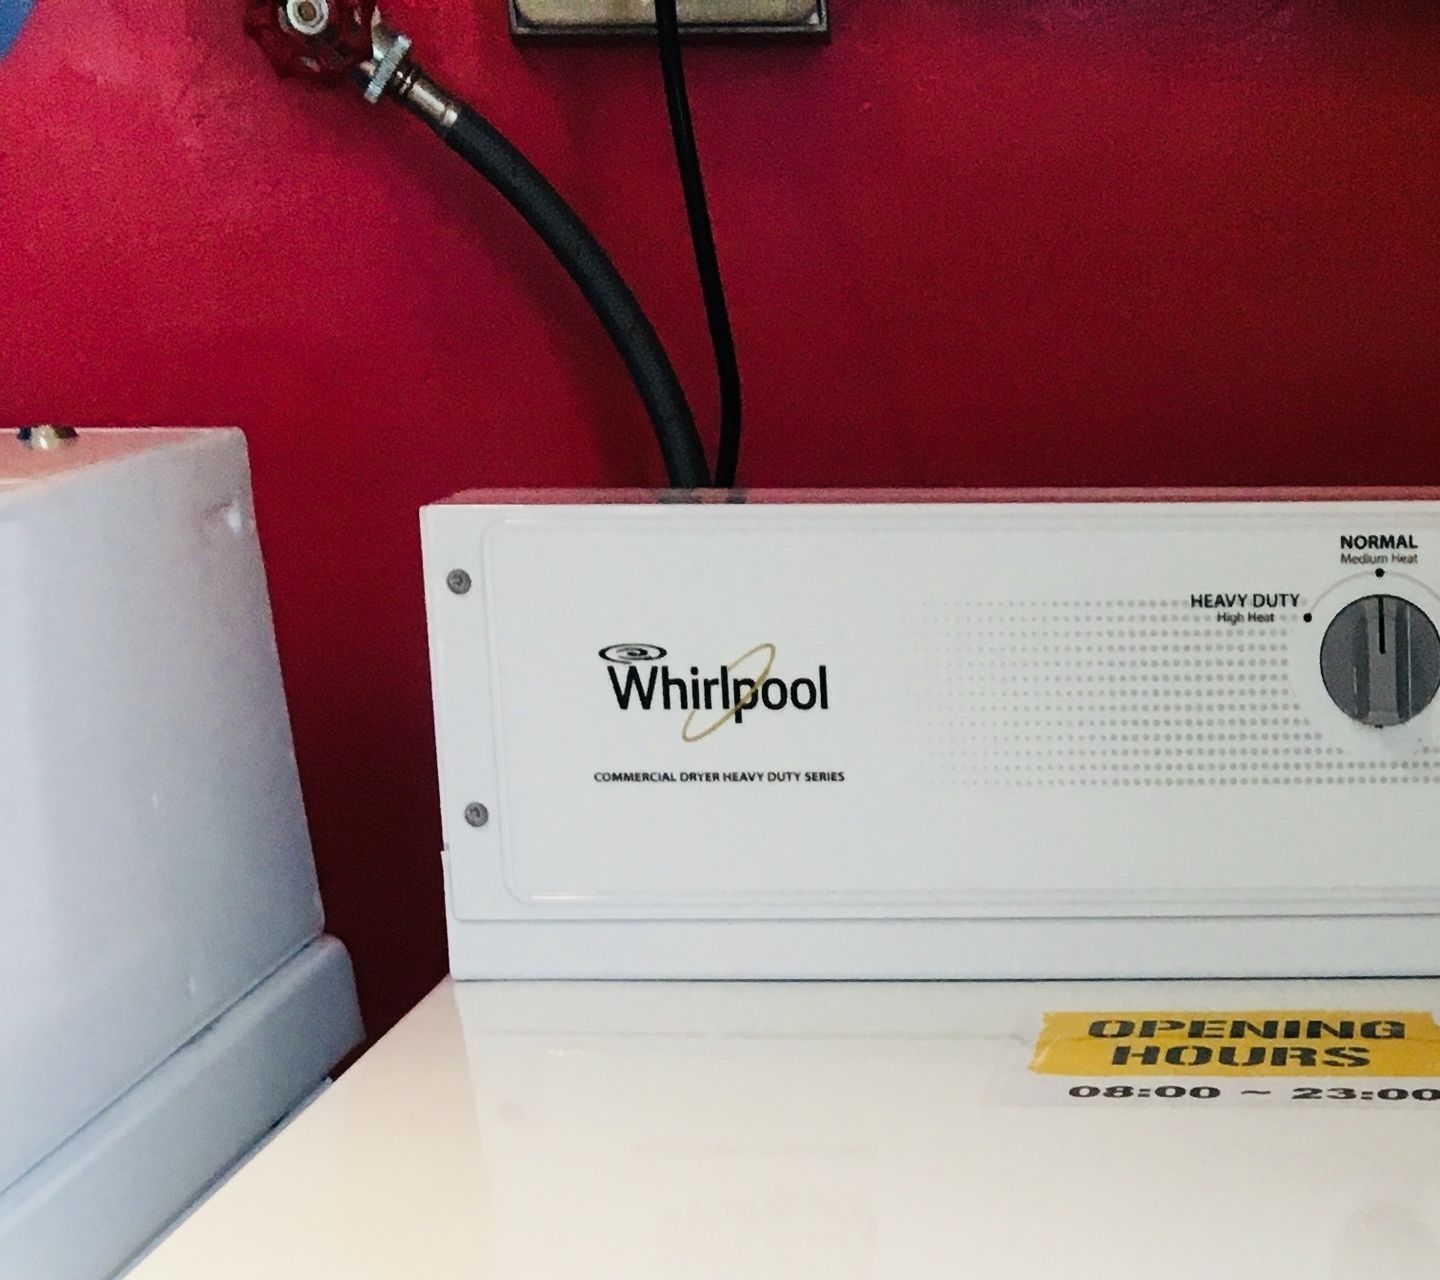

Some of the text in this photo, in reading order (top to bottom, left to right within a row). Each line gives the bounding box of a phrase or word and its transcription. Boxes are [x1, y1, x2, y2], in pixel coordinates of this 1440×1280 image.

[1340, 534, 1418, 550] NORMAL
[1340, 552, 1418, 565] Medium Heat
[1190, 593, 1300, 609] HEAVY DUTY
[1216, 611, 1275, 626] High Heat
[606, 664, 829, 723] Whirlpool
[593, 771, 846, 783] COMMERCIAL DRYER HEAVY DUTY SERIES
[1087, 1019, 1406, 1040] OPENING
[1110, 1045, 1371, 1068] HOURS
[1068, 1085, 1221, 1099] 08:00
